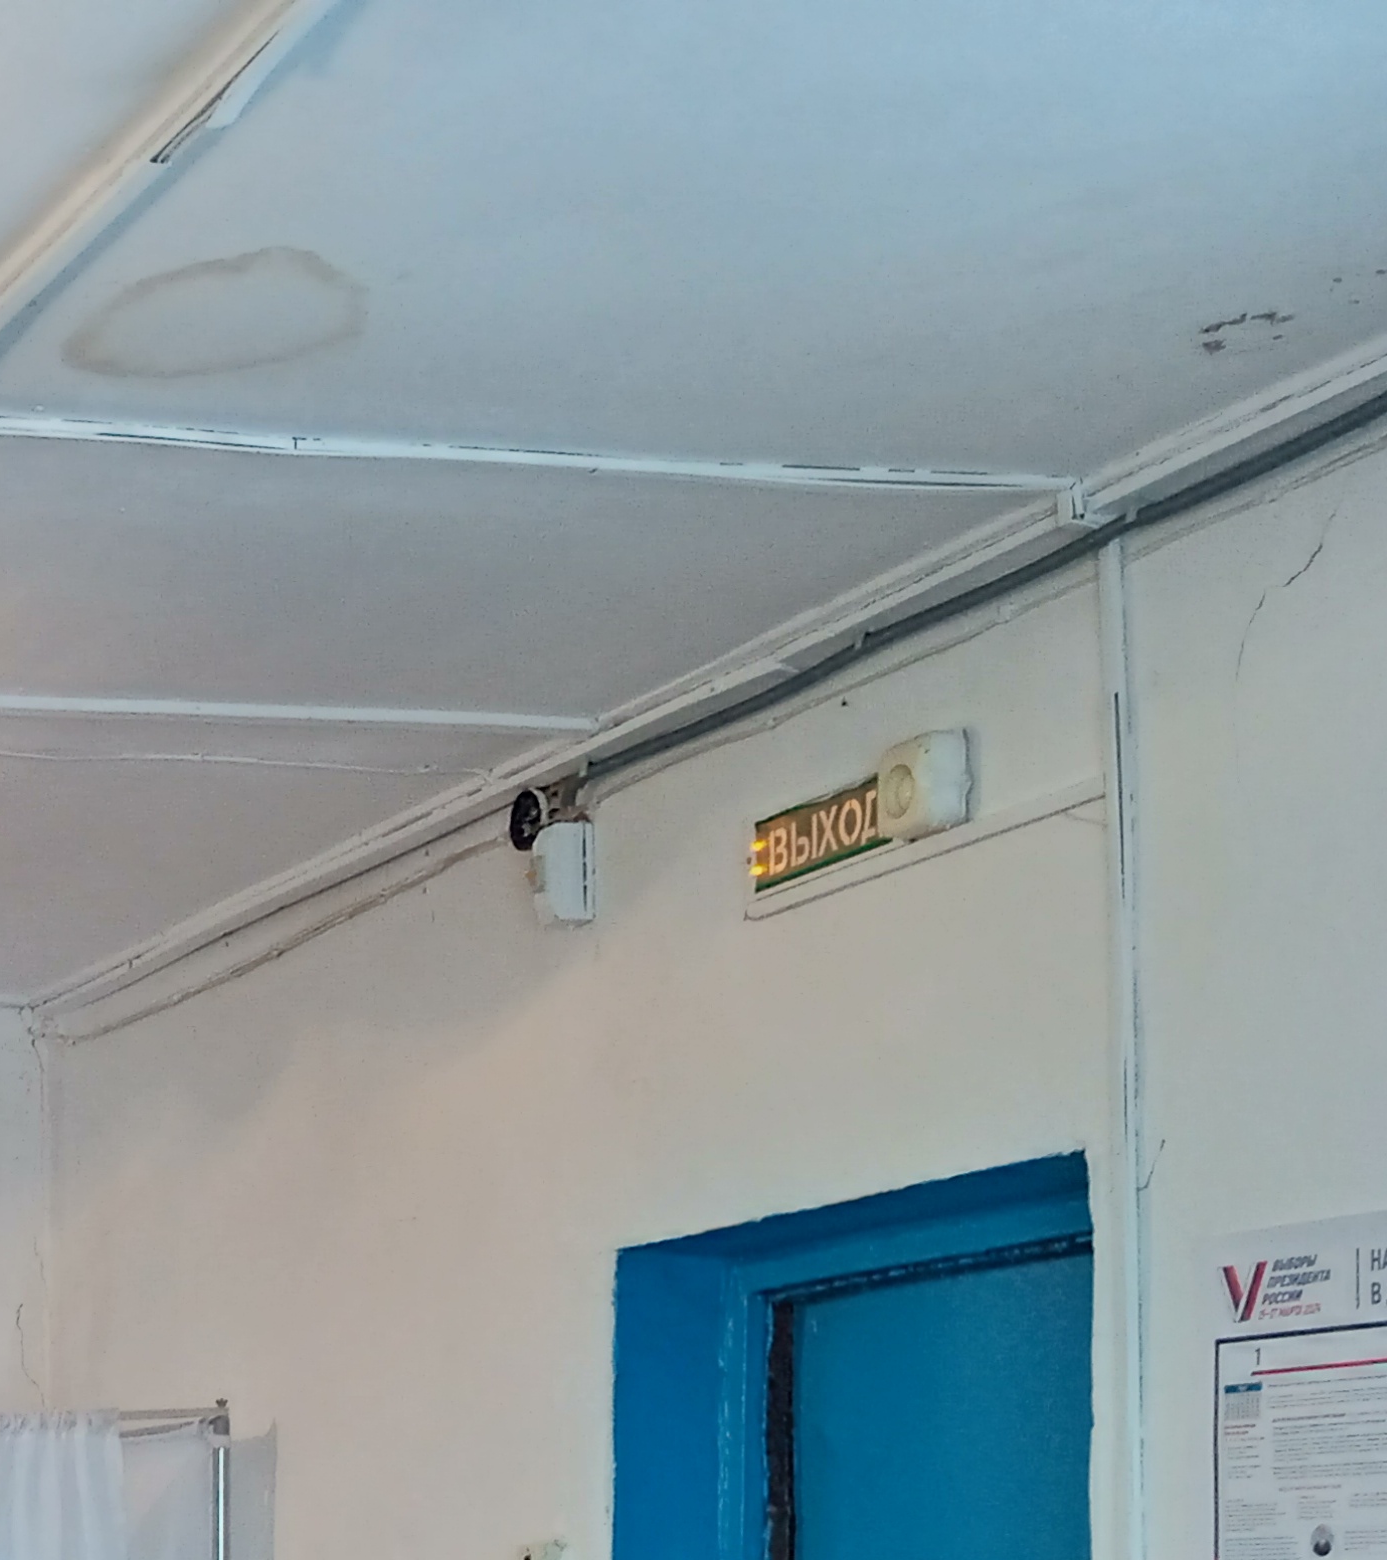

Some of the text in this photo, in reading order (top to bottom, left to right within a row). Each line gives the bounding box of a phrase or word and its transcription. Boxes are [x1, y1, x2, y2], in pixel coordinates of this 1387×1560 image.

[768, 790, 877, 876] ВЫХОД
[1272, 1254, 1318, 1273] ВЫБОРЫ
[1267, 1269, 1331, 1289] ПРЕЗИДЕНТА
[1261, 1289, 1303, 1305] РОССИИ
[1254, 1347, 1261, 1366] 1
